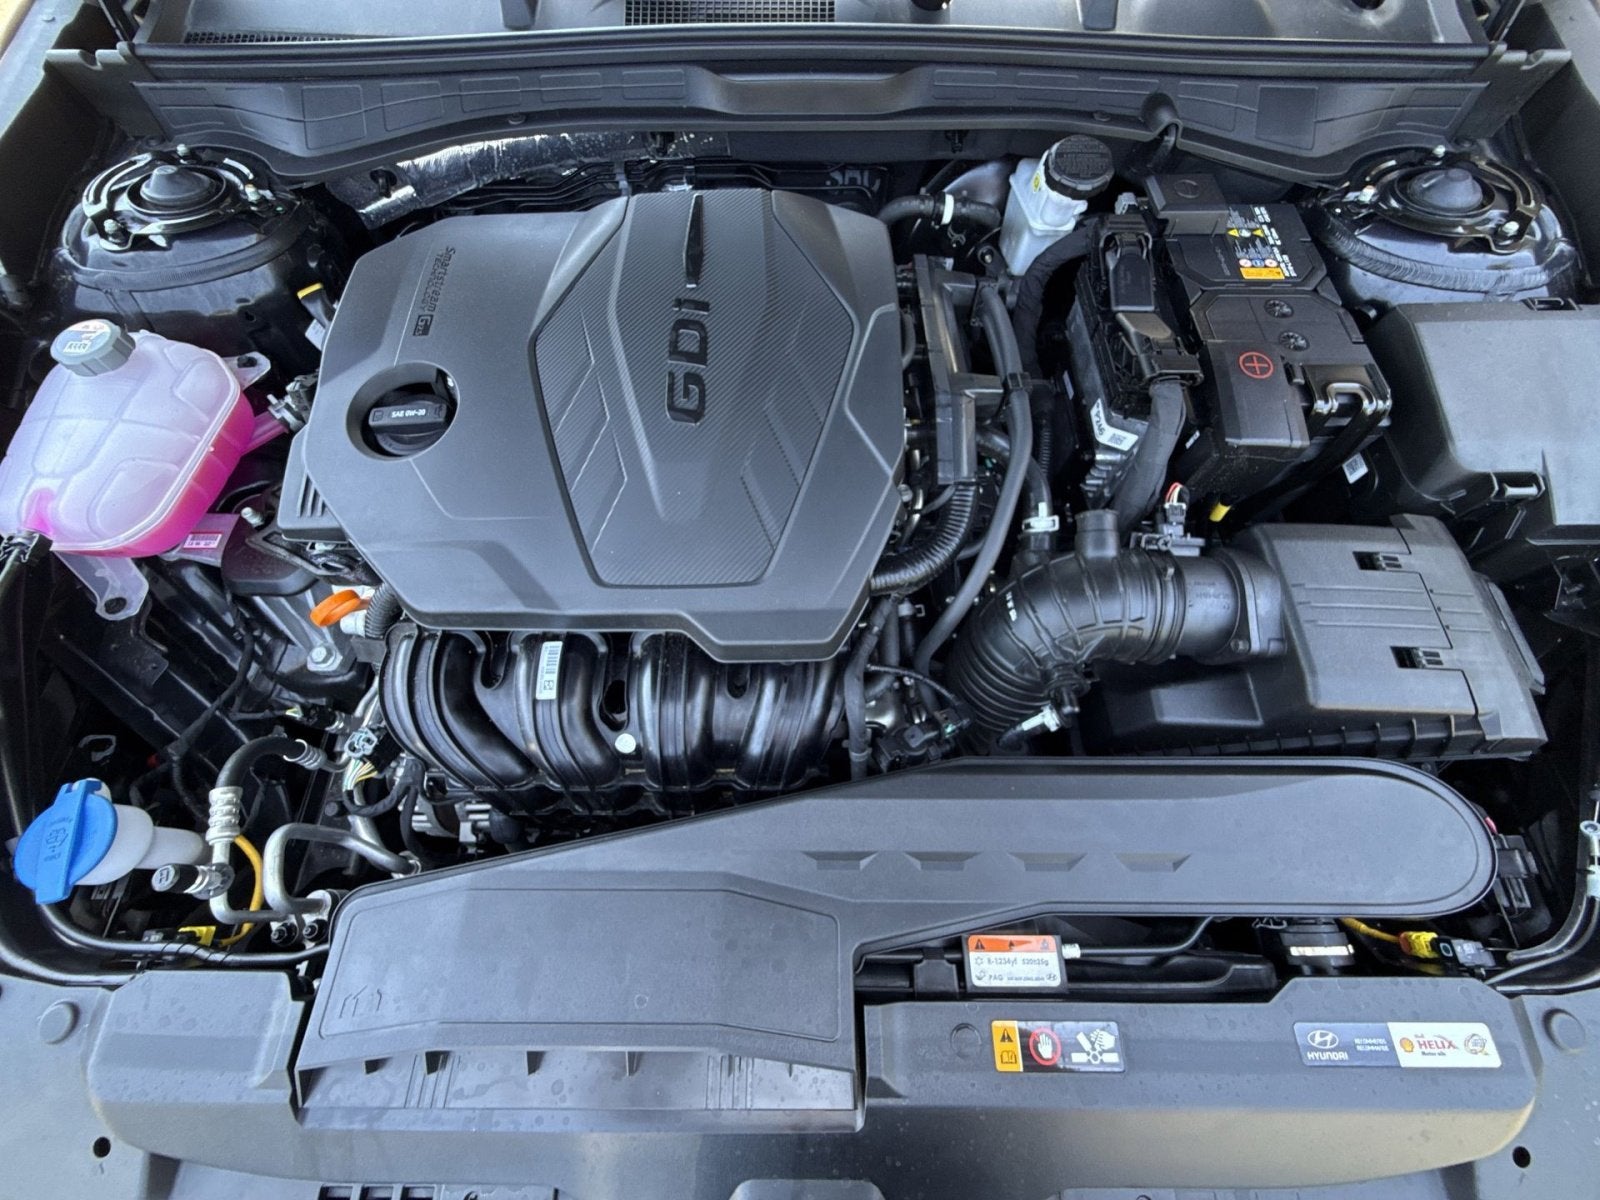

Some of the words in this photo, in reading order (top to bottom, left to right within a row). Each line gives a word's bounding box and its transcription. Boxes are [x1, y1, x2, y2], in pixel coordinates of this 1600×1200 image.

[419, 252, 444, 312] TECHNOLOGY
[427, 246, 456, 312] Smartstream
[391, 410, 404, 419] SAE
[1416, 1039, 1457, 1050] HELIX
[1306, 1050, 1350, 1061] HYUNDAI
